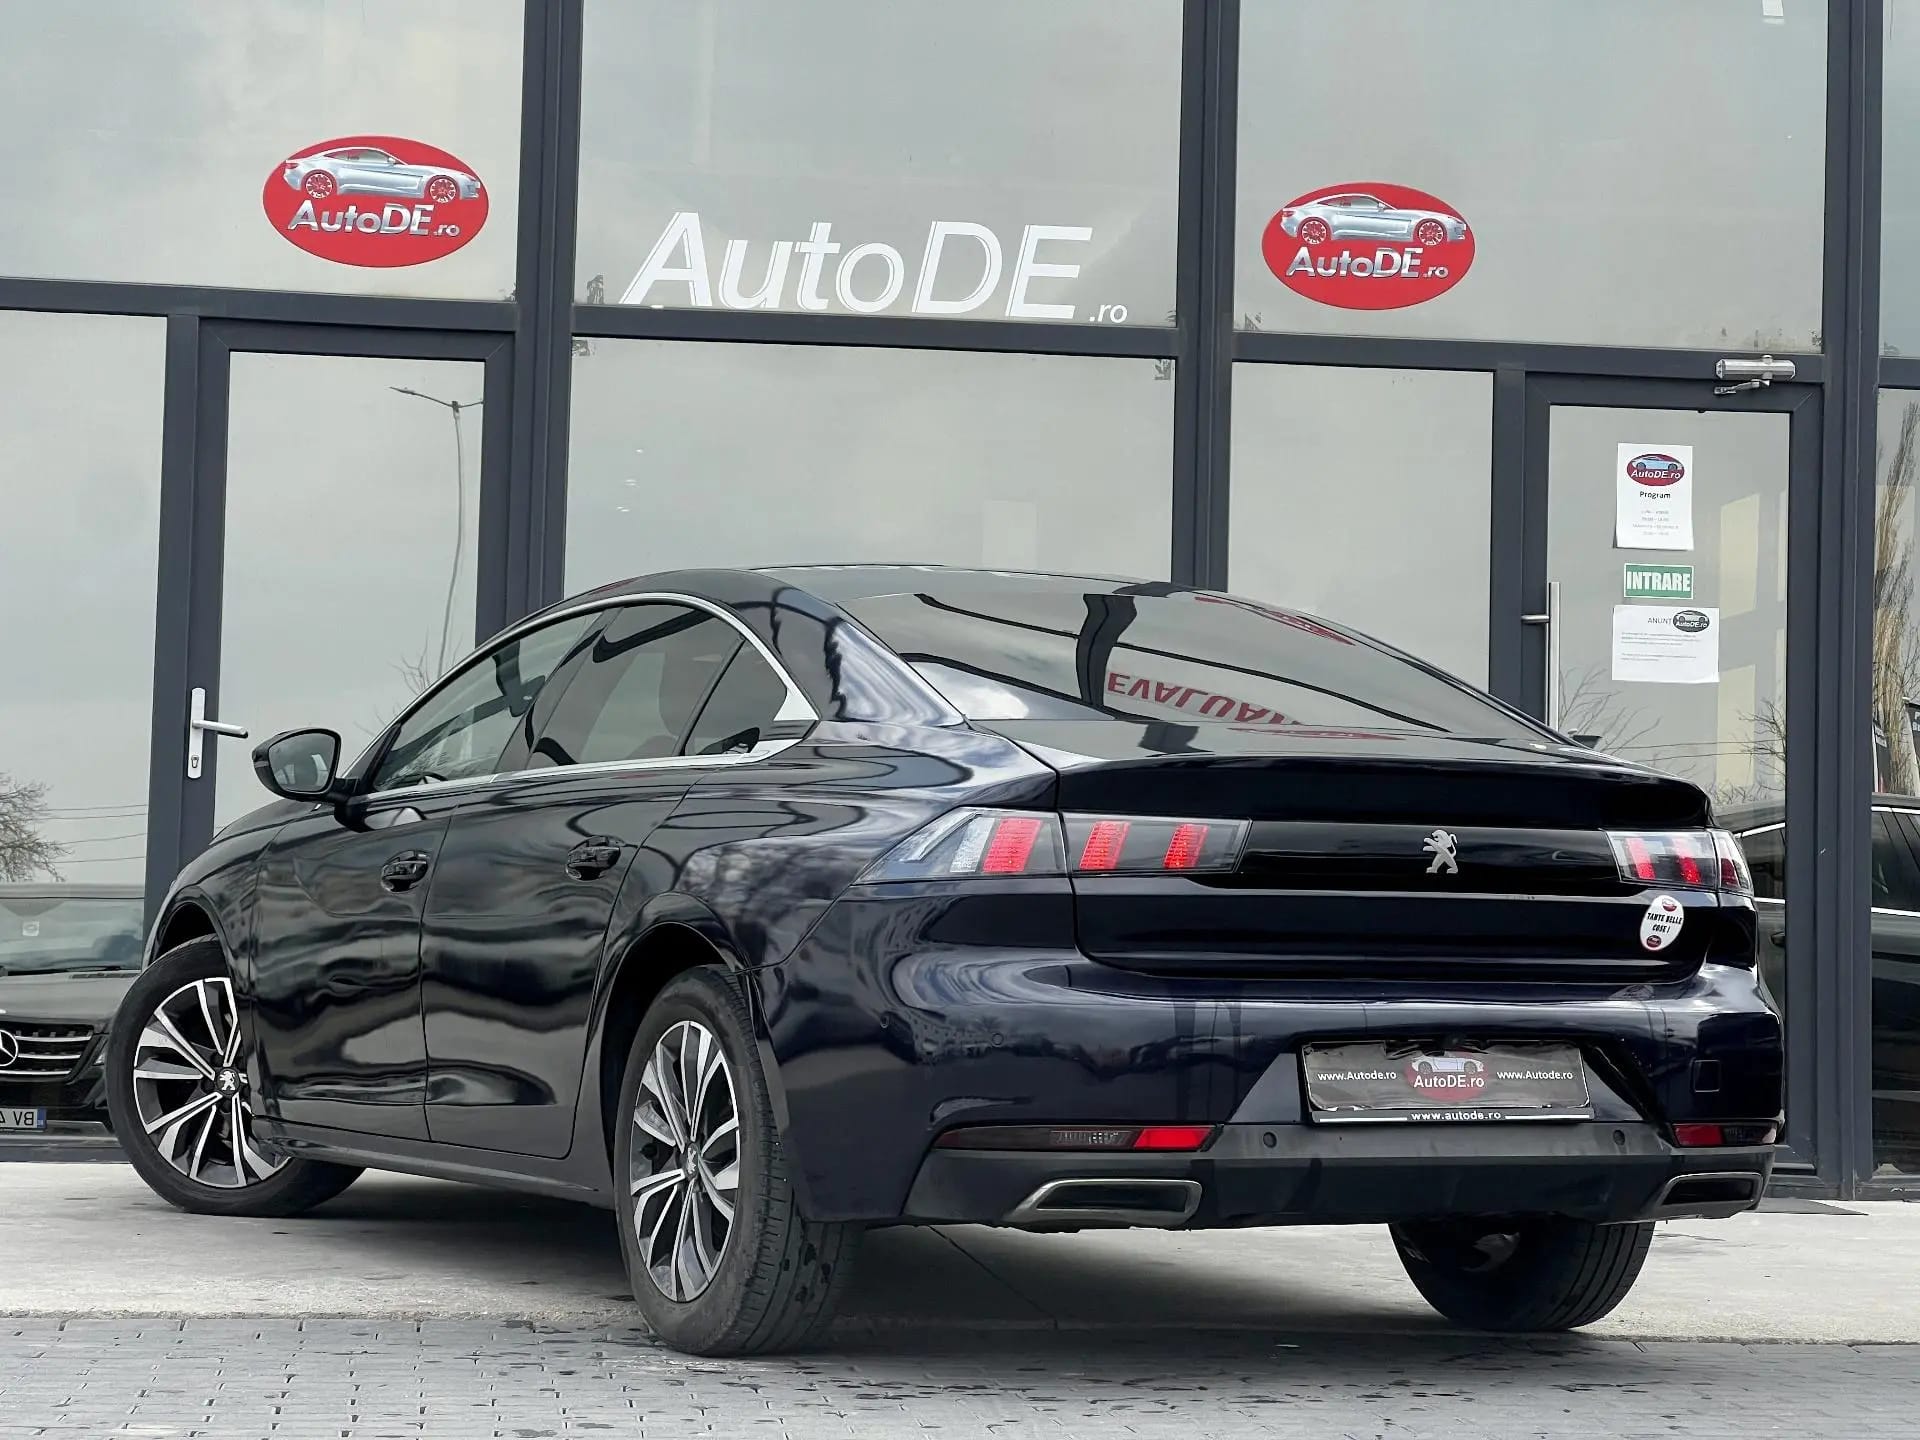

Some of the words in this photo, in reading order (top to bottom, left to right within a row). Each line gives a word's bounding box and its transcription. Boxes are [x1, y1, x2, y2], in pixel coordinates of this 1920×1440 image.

[1631, 469, 1681, 479] AutoDE.ro
[1639, 491, 1671, 499] Program
[1626, 571, 1691, 592] INTRARE
[1647, 912, 1665, 921] TANTE
[1666, 915, 1683, 924] BELLE
[1317, 1070, 1397, 1081] www.Autode.ro
[1496, 1070, 1573, 1080] www.Autode.ro
[1413, 1074, 1485, 1088] AutoDE.ro
[1411, 1110, 1501, 1121] www.autode.ro
